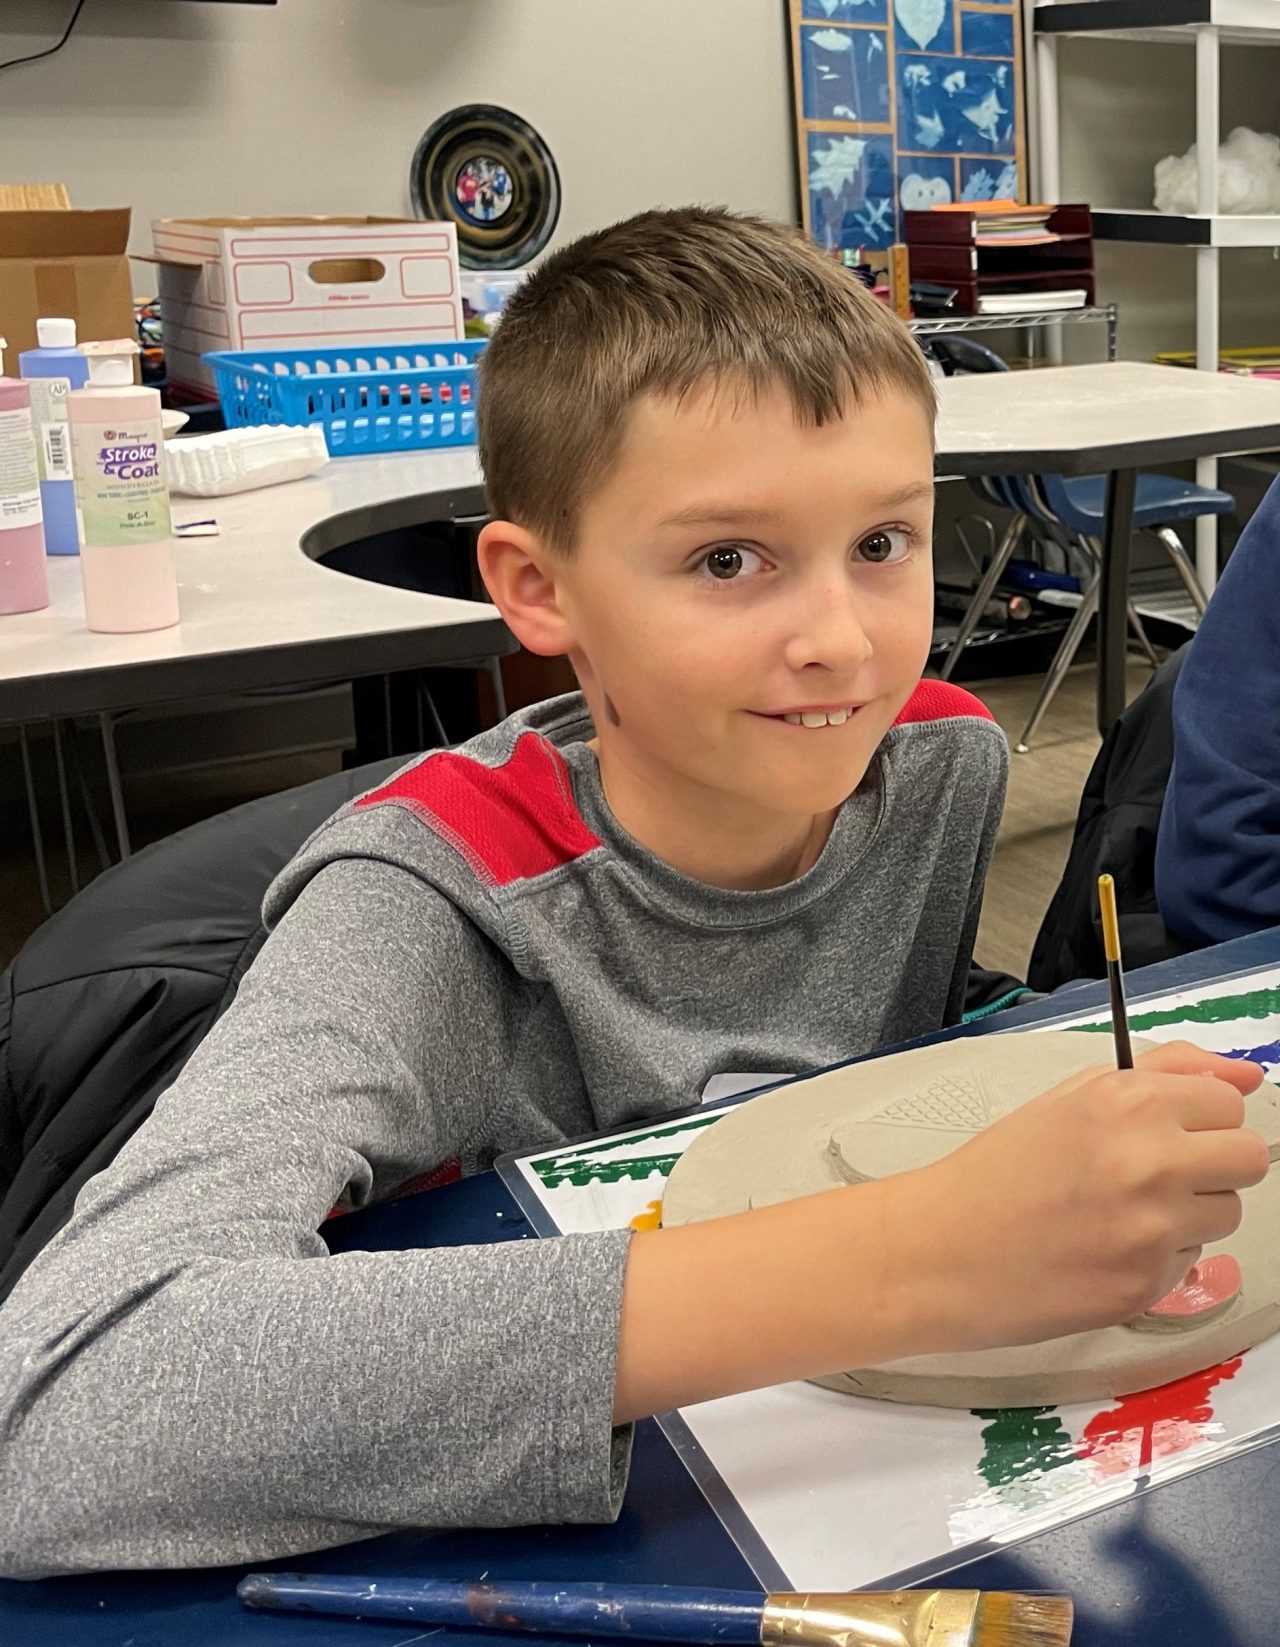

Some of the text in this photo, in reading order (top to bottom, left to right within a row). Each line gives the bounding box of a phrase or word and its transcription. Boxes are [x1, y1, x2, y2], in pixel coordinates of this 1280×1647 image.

[105, 446, 154, 463] Stroke
[103, 462, 159, 480] & Coat
